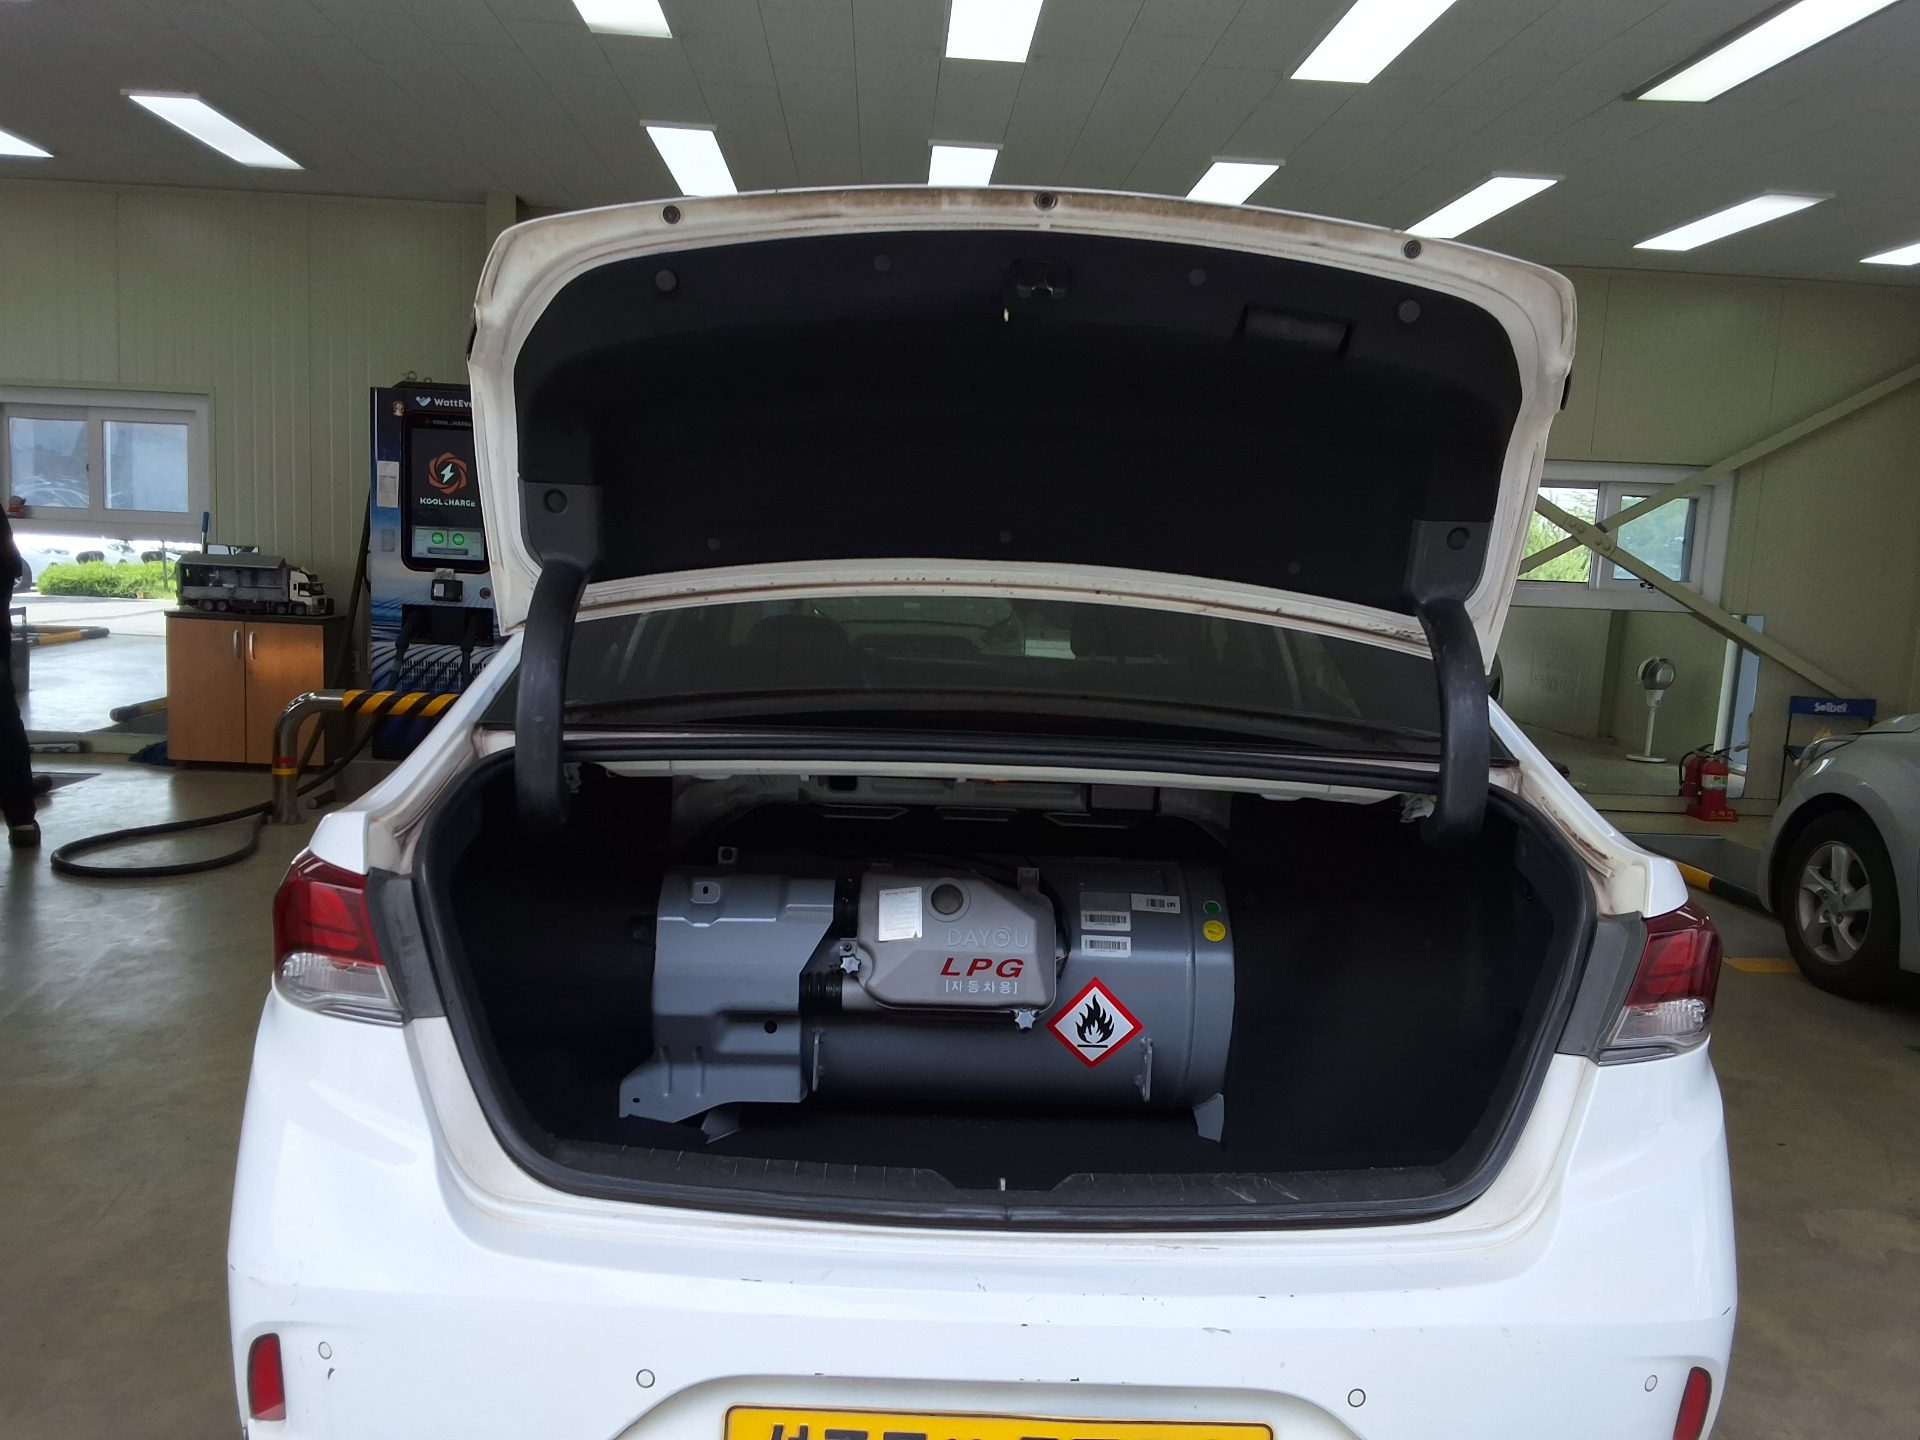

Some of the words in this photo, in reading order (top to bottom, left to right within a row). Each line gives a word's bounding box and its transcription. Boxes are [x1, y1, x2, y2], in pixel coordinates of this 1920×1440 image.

[946, 926, 1029, 948] DAYOU
[940, 957, 1025, 978] LPG
[945, 979, 1018, 995] [자동차용]
